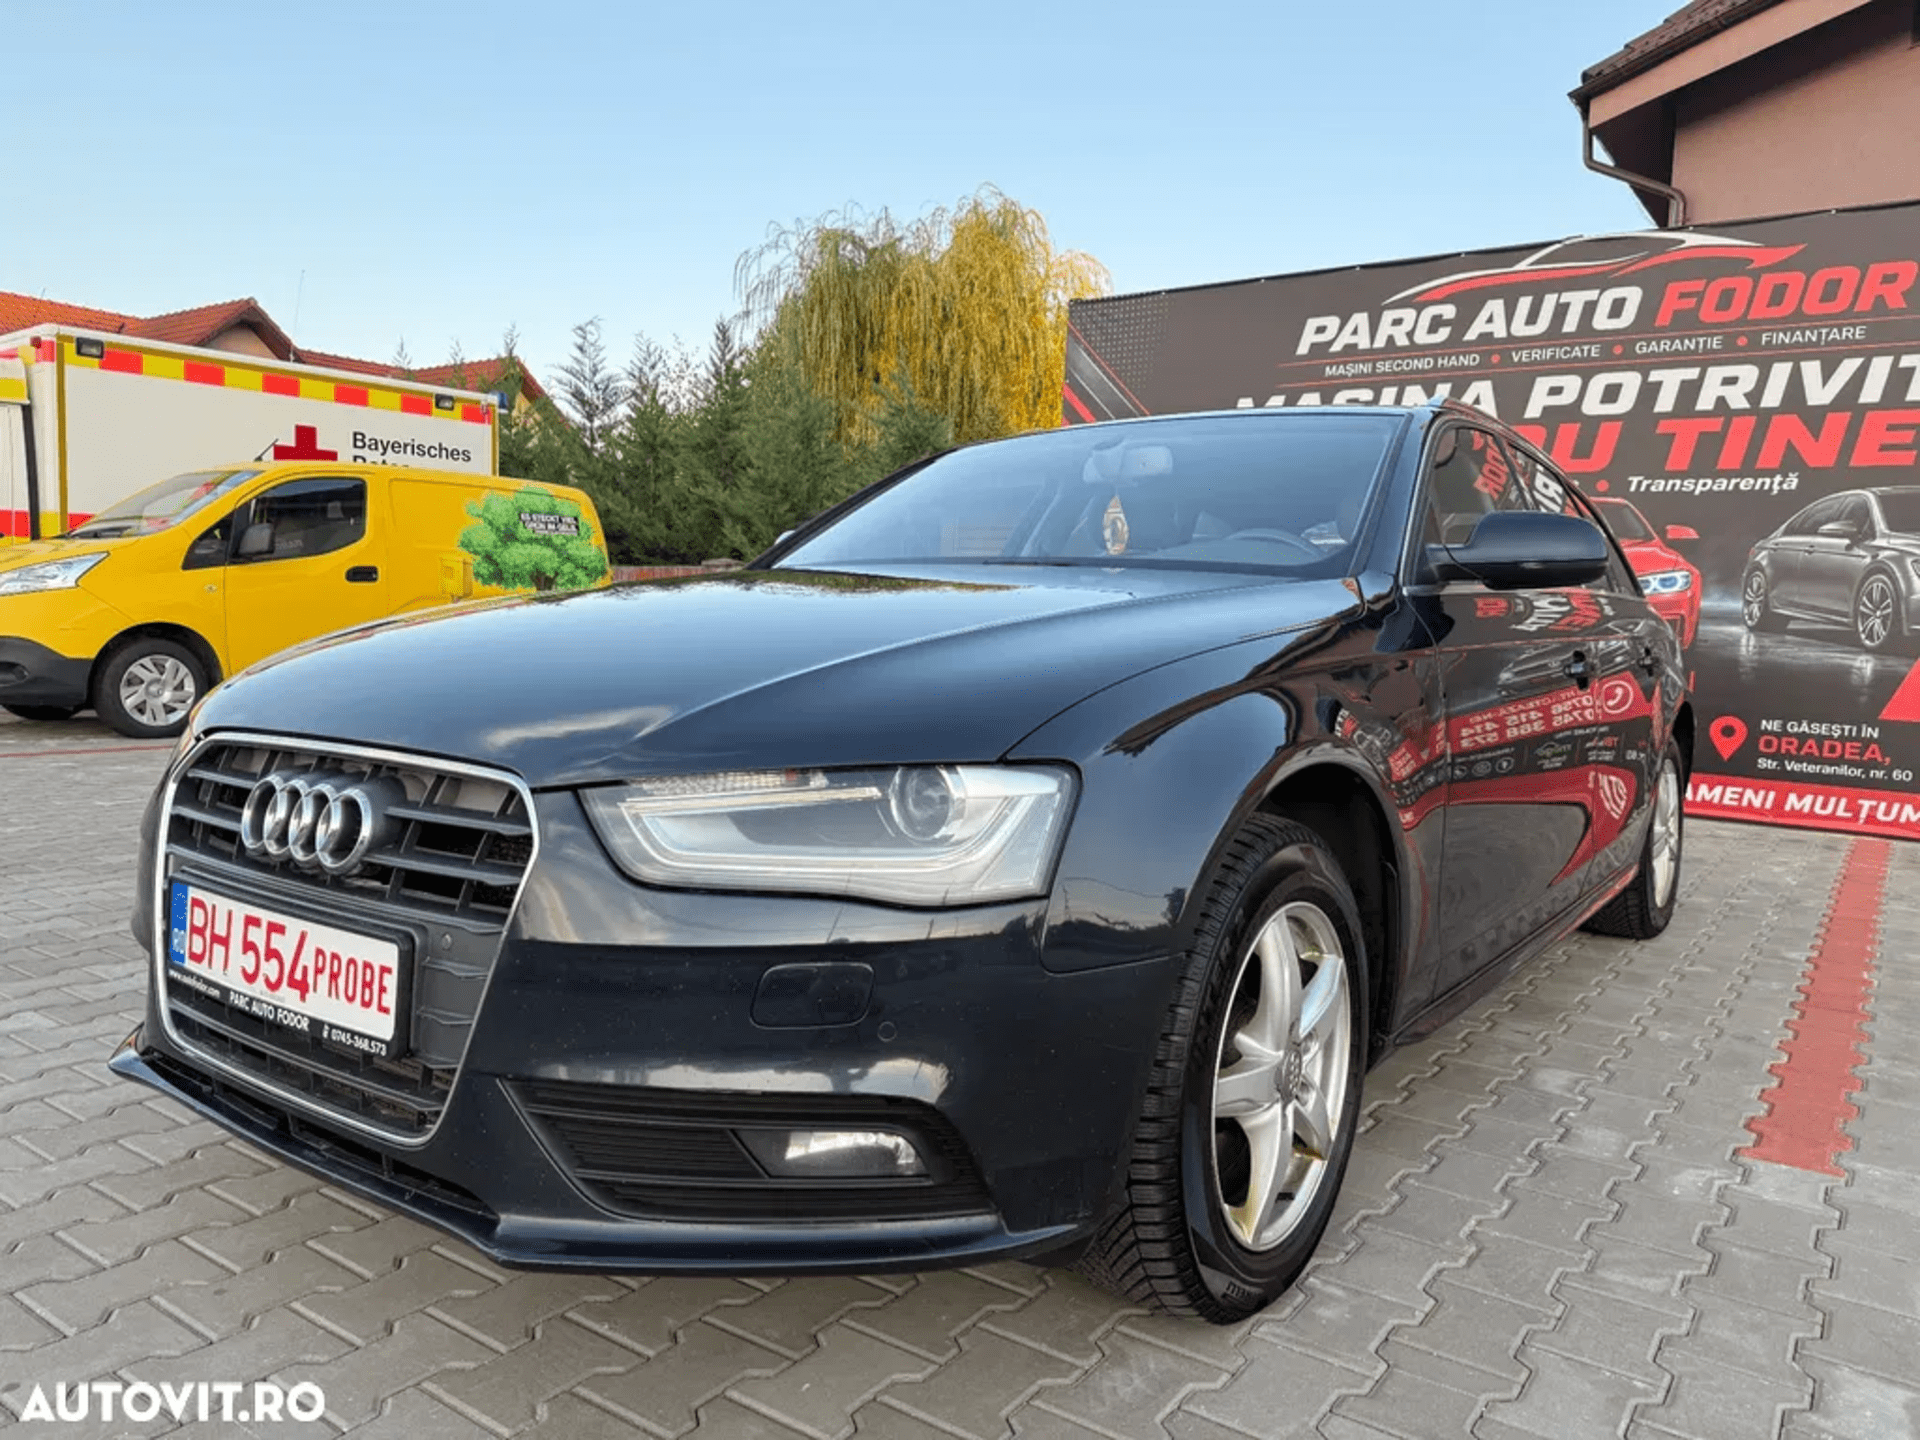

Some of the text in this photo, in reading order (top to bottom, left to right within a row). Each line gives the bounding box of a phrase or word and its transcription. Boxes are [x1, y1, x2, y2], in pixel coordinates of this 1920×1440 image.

[1295, 260, 1918, 355] PARC AUTO FODOR
[1376, 357, 1434, 373] SECOND
[1437, 354, 1480, 368] HAND
[1511, 344, 1601, 363] VERIFICATE
[1634, 335, 1723, 355] GARANȚIE
[1761, 325, 1866, 346] FINANȚARE
[352, 431, 471, 462] Bayerisches
[1655, 408, 1920, 471] TINE
[1760, 719, 1784, 731] NE
[1861, 723, 1879, 738] ÎN
[1757, 735, 1891, 765] ORADEA,
[1757, 757, 1913, 782] Str. Veteranilor, nr. 60
[187, 896, 393, 1015] BH 554 PROBE
[229, 991, 250, 1012] PARC
[250, 1003, 275, 1021] AUTO
[277, 1011, 310, 1032] FODOR
